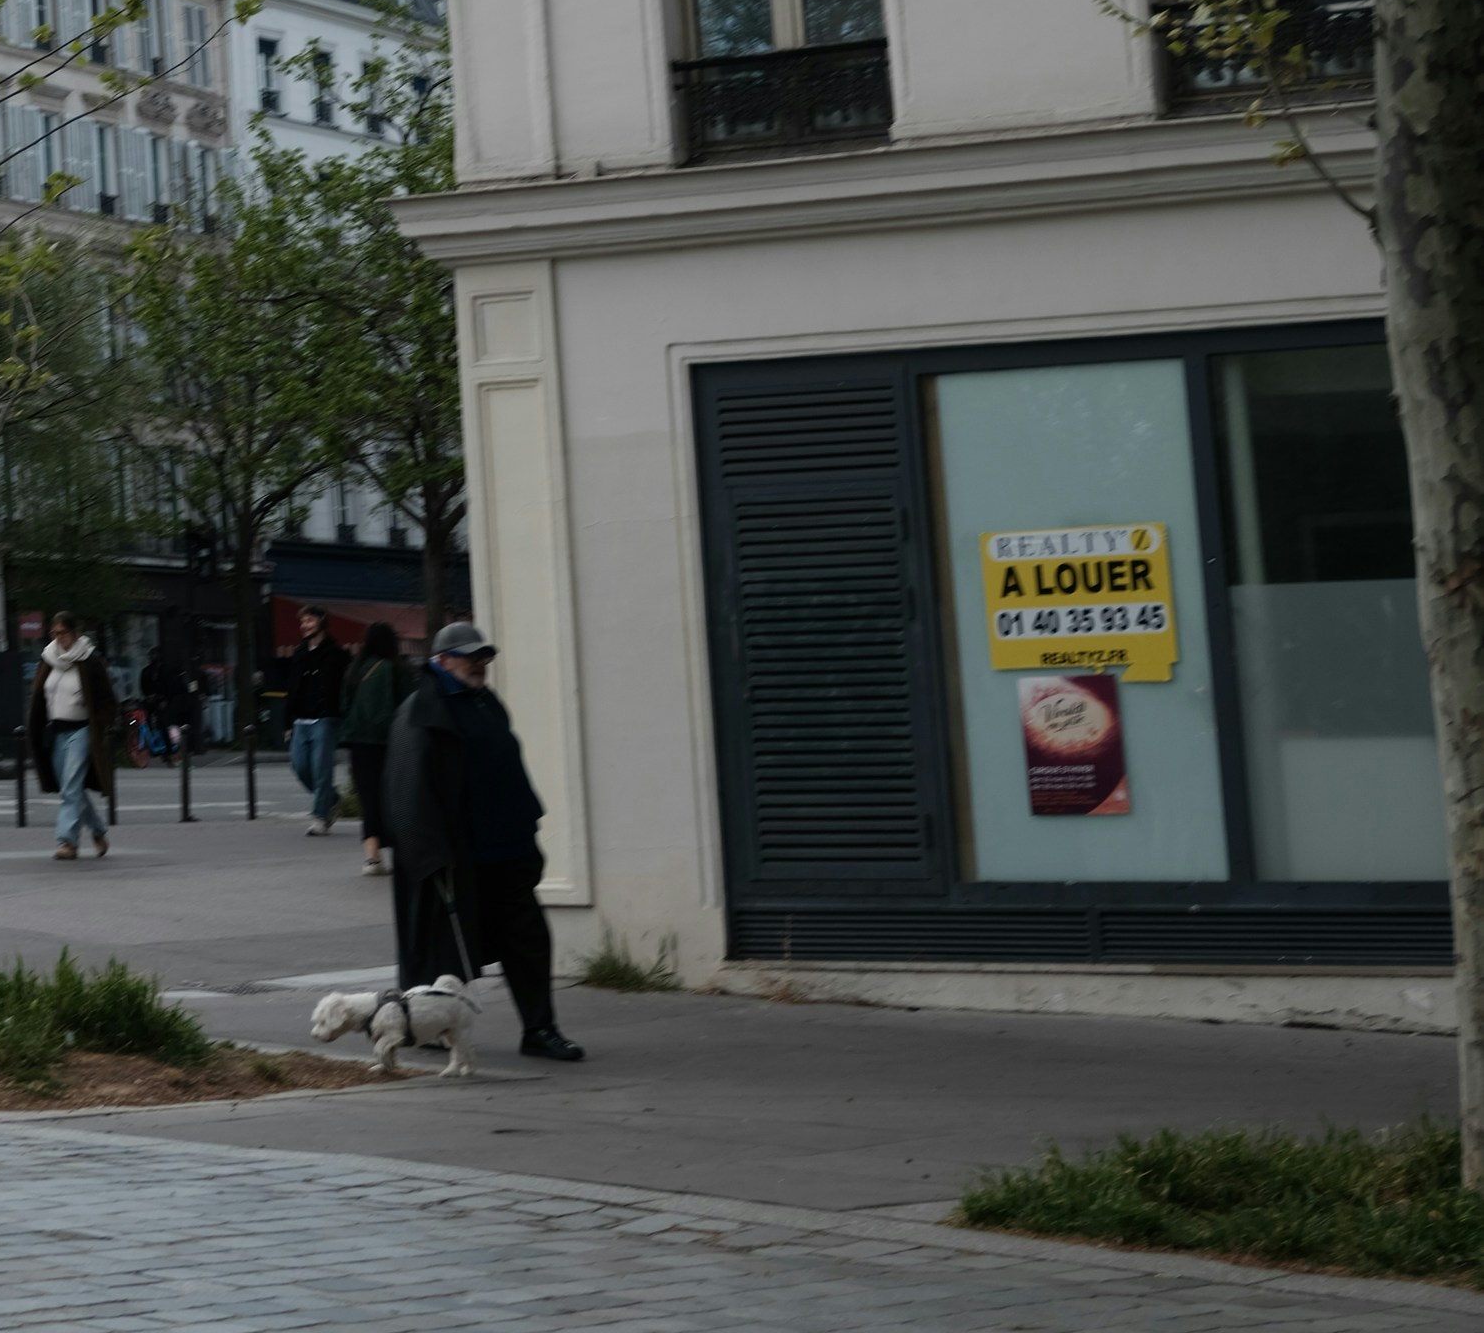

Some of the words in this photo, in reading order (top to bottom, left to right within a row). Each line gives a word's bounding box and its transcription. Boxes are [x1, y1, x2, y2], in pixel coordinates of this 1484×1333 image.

[1001, 566, 1024, 598] A
[1034, 559, 1154, 596] LOUER
[997, 611, 1025, 638] 01
[1031, 609, 1060, 635] 40
[1066, 608, 1096, 633] 35
[1100, 606, 1130, 632] 93
[1135, 604, 1166, 630] 45
